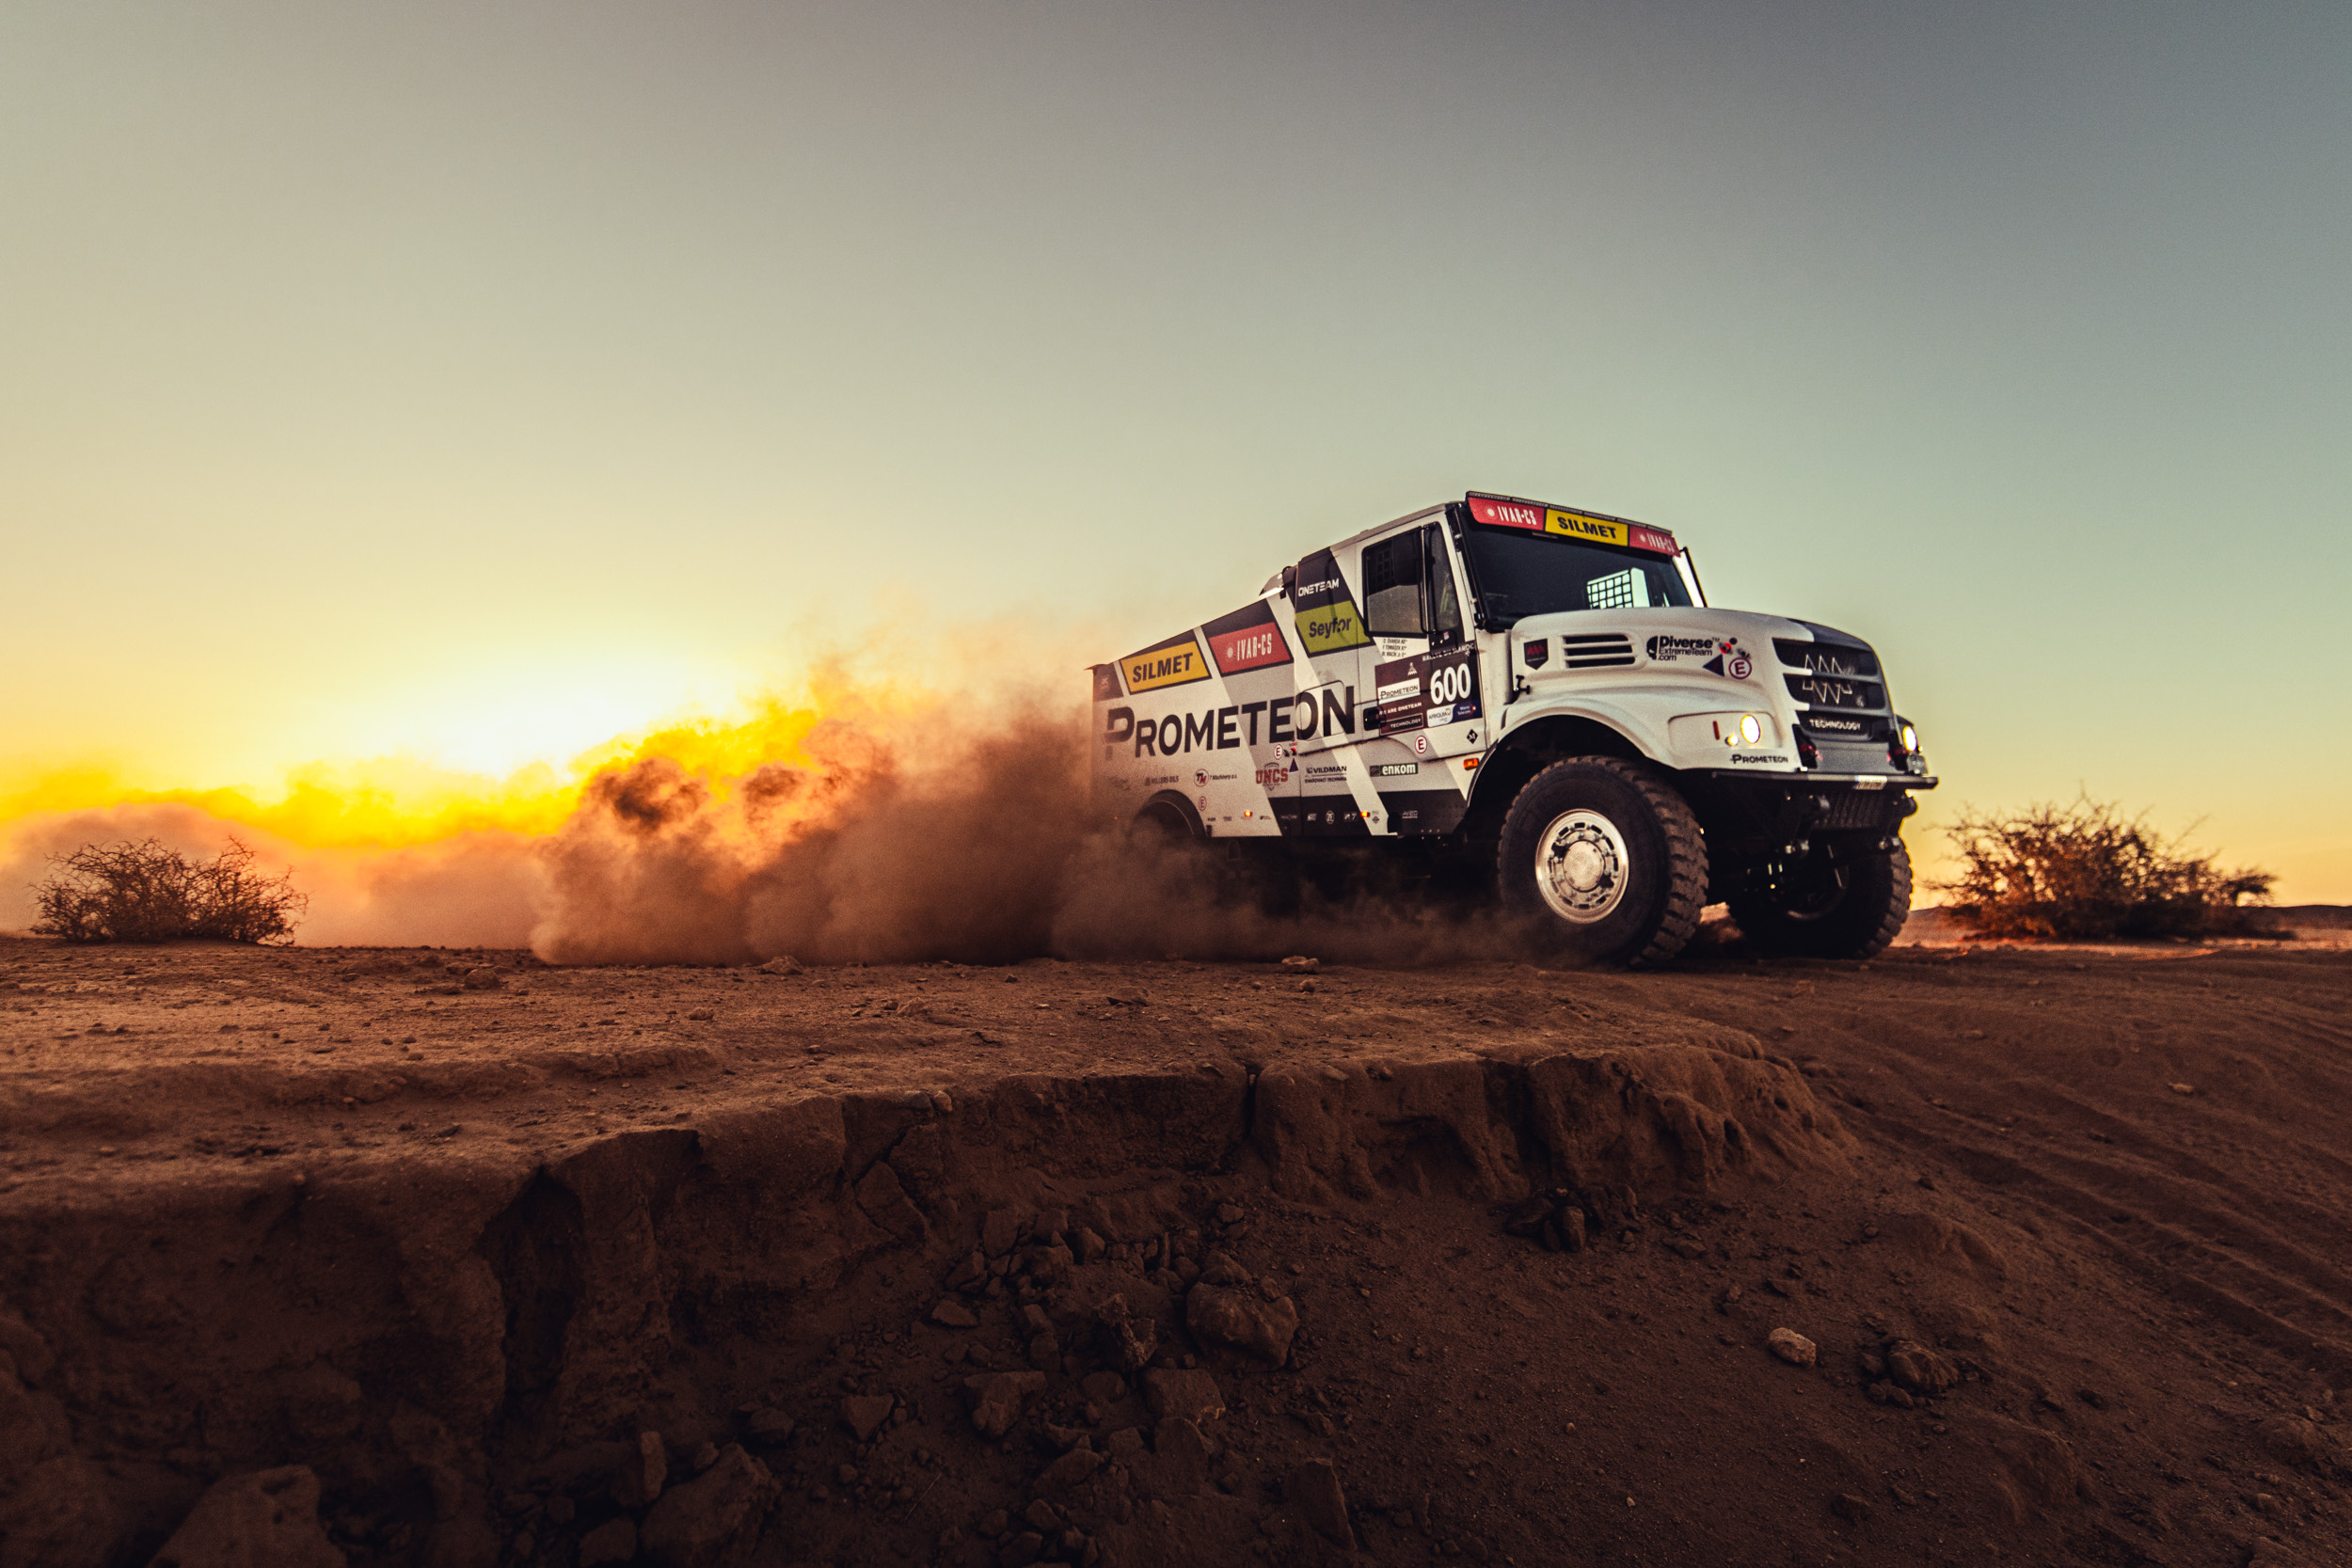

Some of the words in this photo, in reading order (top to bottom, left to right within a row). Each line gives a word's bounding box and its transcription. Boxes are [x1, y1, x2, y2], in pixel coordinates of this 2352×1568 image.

[1557, 516, 1616, 539] SILMET
[1298, 578, 1340, 597] ONETEAM
[1309, 617, 1352, 639] Seyfor
[1659, 636, 1713, 649] Diverse
[1133, 652, 1193, 683] SILMET
[1734, 661, 1746, 675] E
[1430, 663, 1471, 705] 600
[1380, 685, 1419, 699] PROMETEON
[1398, 702, 1422, 712] ONETEAM
[1104, 686, 1356, 761] PROMETEON
[1391, 719, 1422, 729] TECHNOLOGY
[1809, 719, 1861, 730] TECHNOLOGY
[1418, 739, 1424, 750] E
[1730, 753, 1788, 764] PROMETEON
[1382, 764, 1416, 775] enkom
